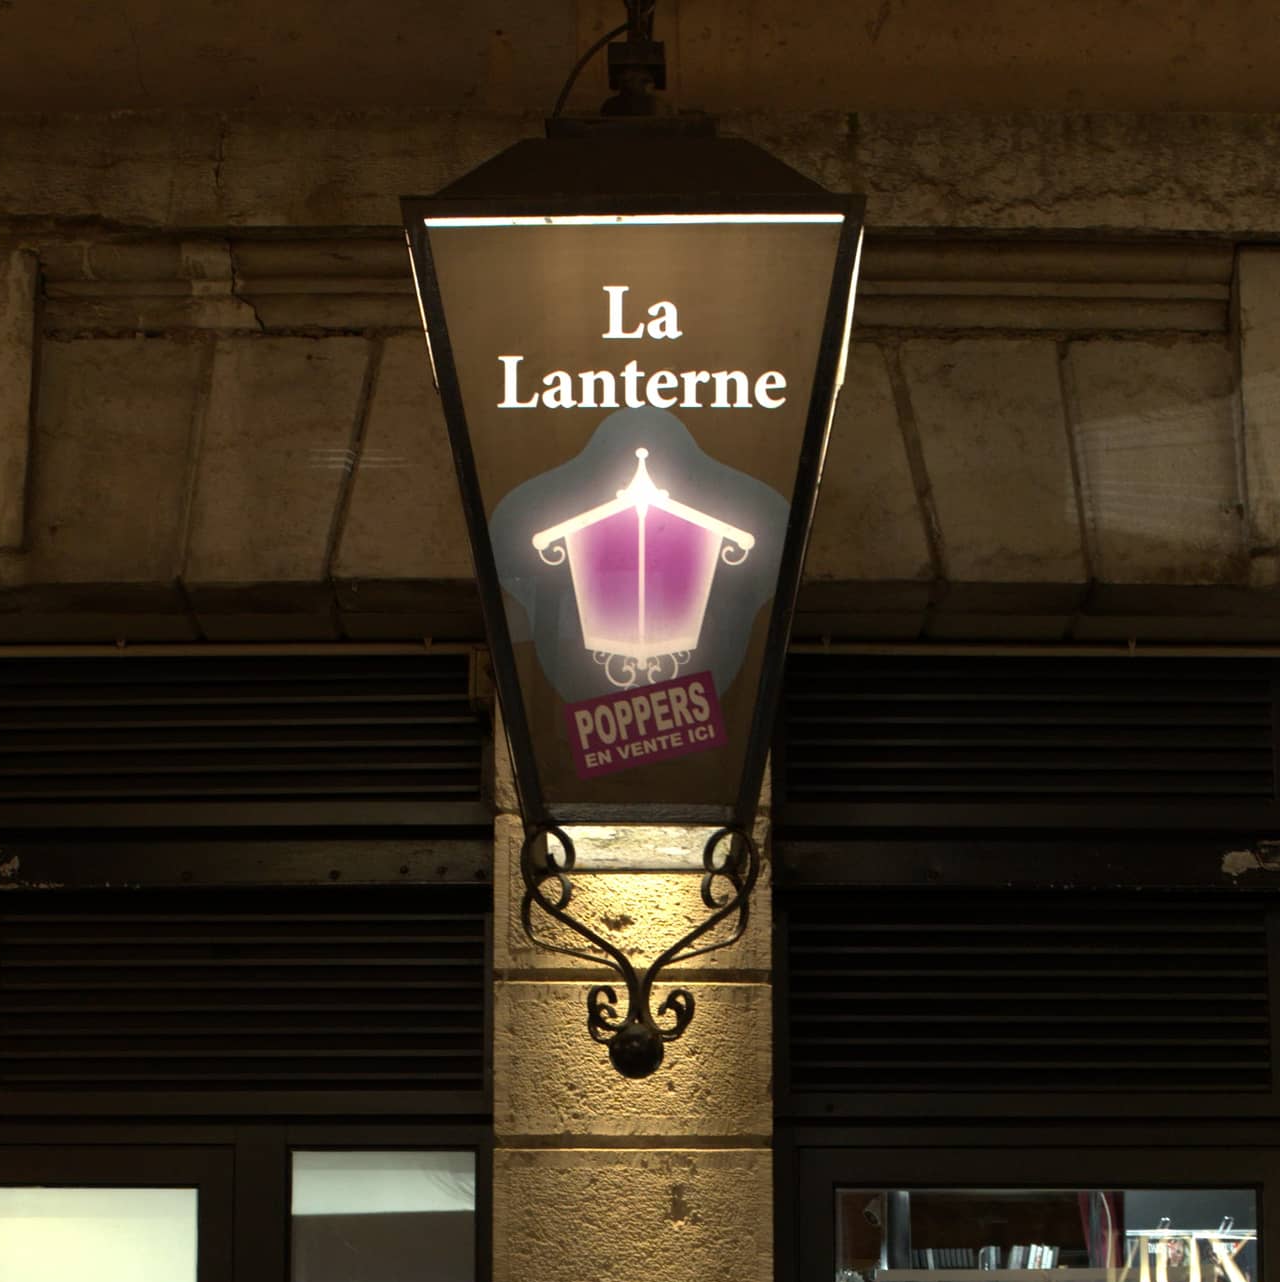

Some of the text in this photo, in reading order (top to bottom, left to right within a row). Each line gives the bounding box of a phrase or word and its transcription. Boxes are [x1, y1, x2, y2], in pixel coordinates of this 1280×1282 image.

[602, 285, 683, 340] La
[496, 355, 787, 409] Lanterne
[574, 681, 711, 750] POPPERS
[584, 724, 716, 769] EN VENTE ICI
